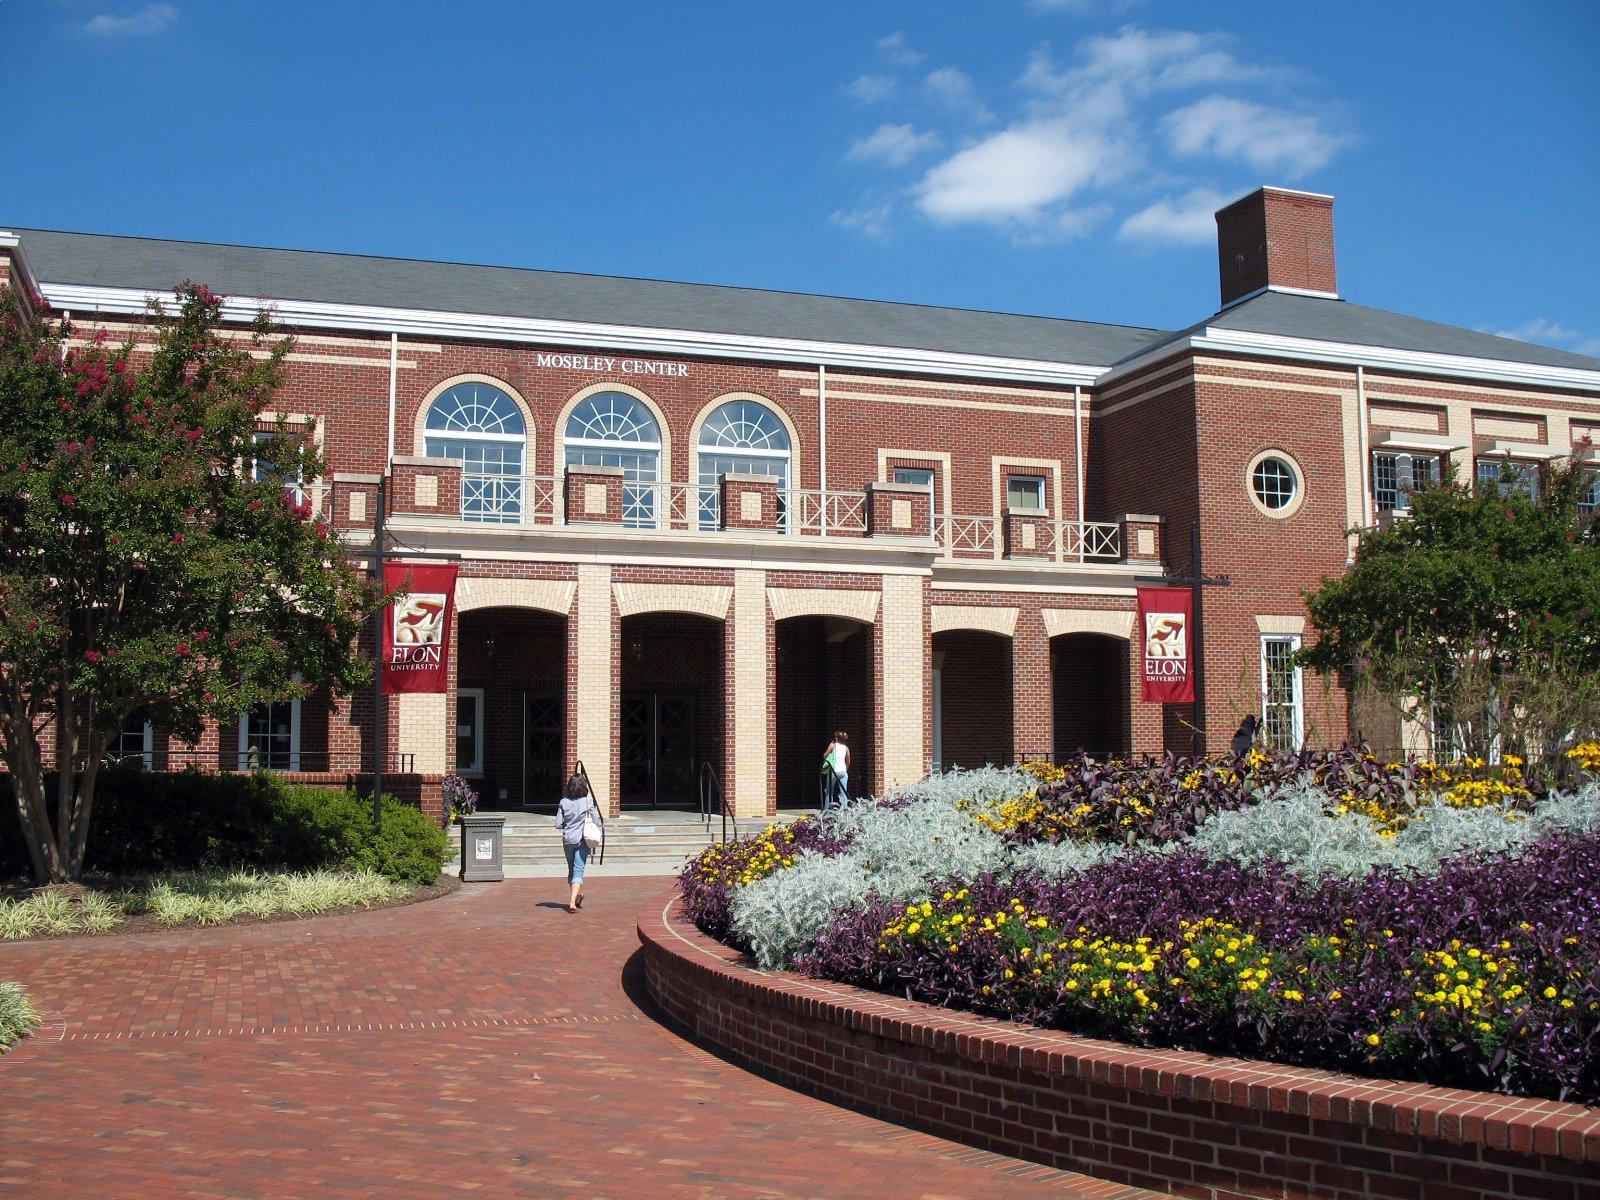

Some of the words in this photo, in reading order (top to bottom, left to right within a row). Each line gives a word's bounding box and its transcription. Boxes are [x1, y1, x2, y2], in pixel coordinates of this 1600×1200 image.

[537, 354, 616, 372] MOSELEY
[621, 359, 689, 377] CENTER
[390, 646, 442, 663] ELON
[1145, 660, 1187, 675] ELON
